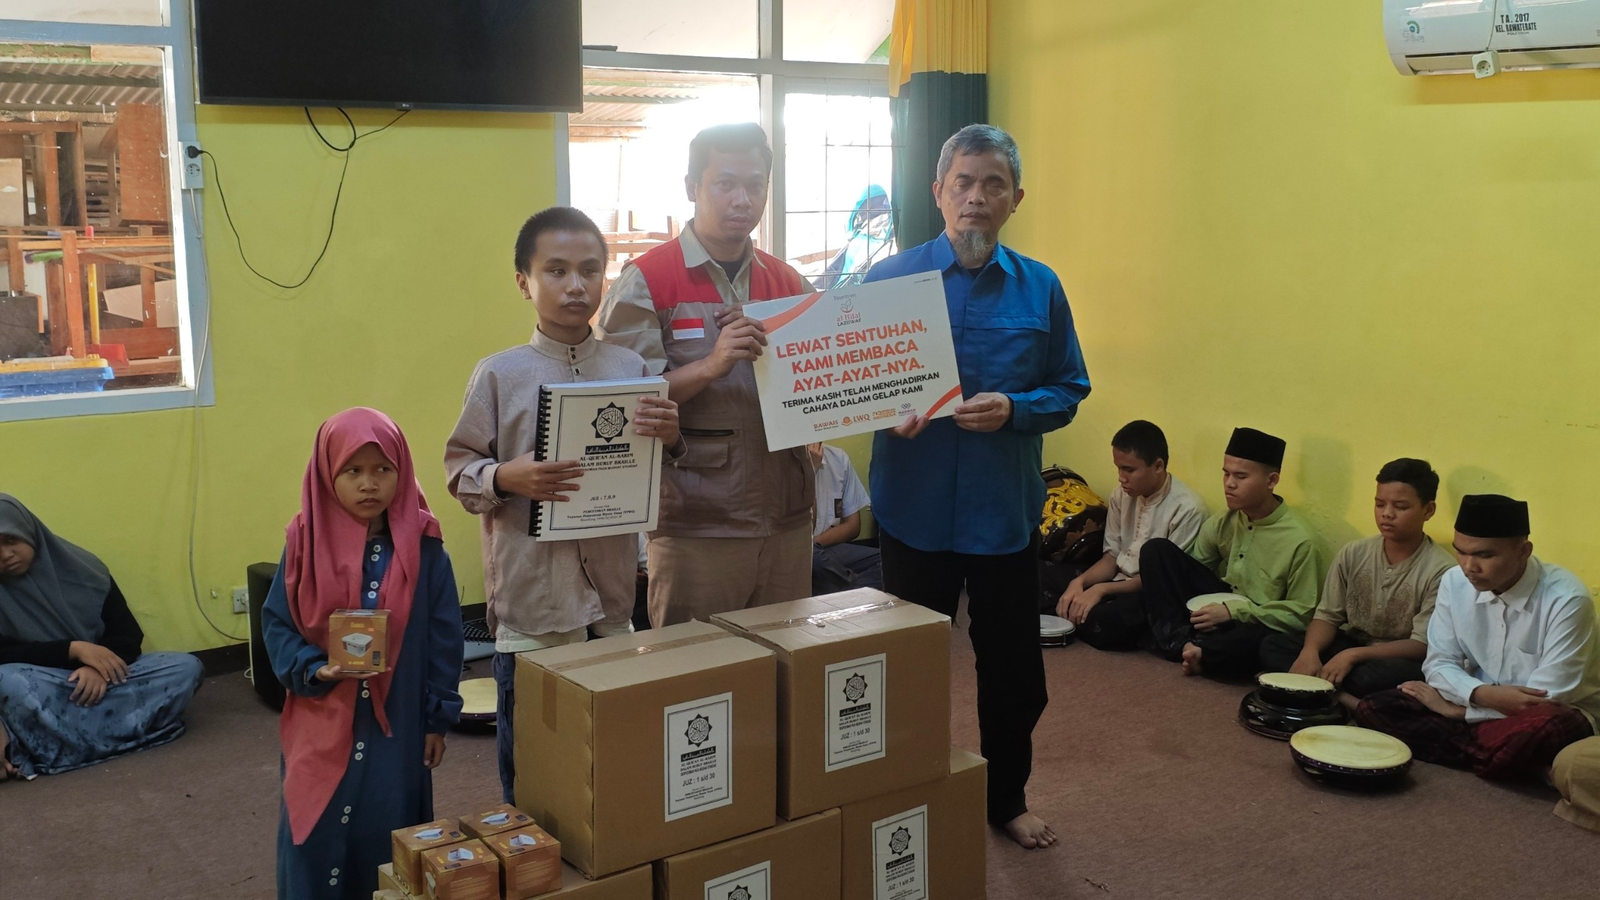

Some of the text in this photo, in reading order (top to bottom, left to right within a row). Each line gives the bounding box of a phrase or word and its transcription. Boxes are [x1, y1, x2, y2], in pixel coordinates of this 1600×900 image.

[1500, 13, 1529, 23] TA. 2017
[776, 319, 927, 358] LEWAT SENTUHAN,
[792, 339, 918, 374] KAMI MEMBACA
[782, 372, 940, 408] TERIMA KASIH TELAH MENGHADIRKAN
[793, 357, 925, 393] AYAT-AYAT-NYA.
[803, 385, 923, 414] CAHAYA DALAM GELAP KAMI
[853, 414, 870, 423] LWQ
